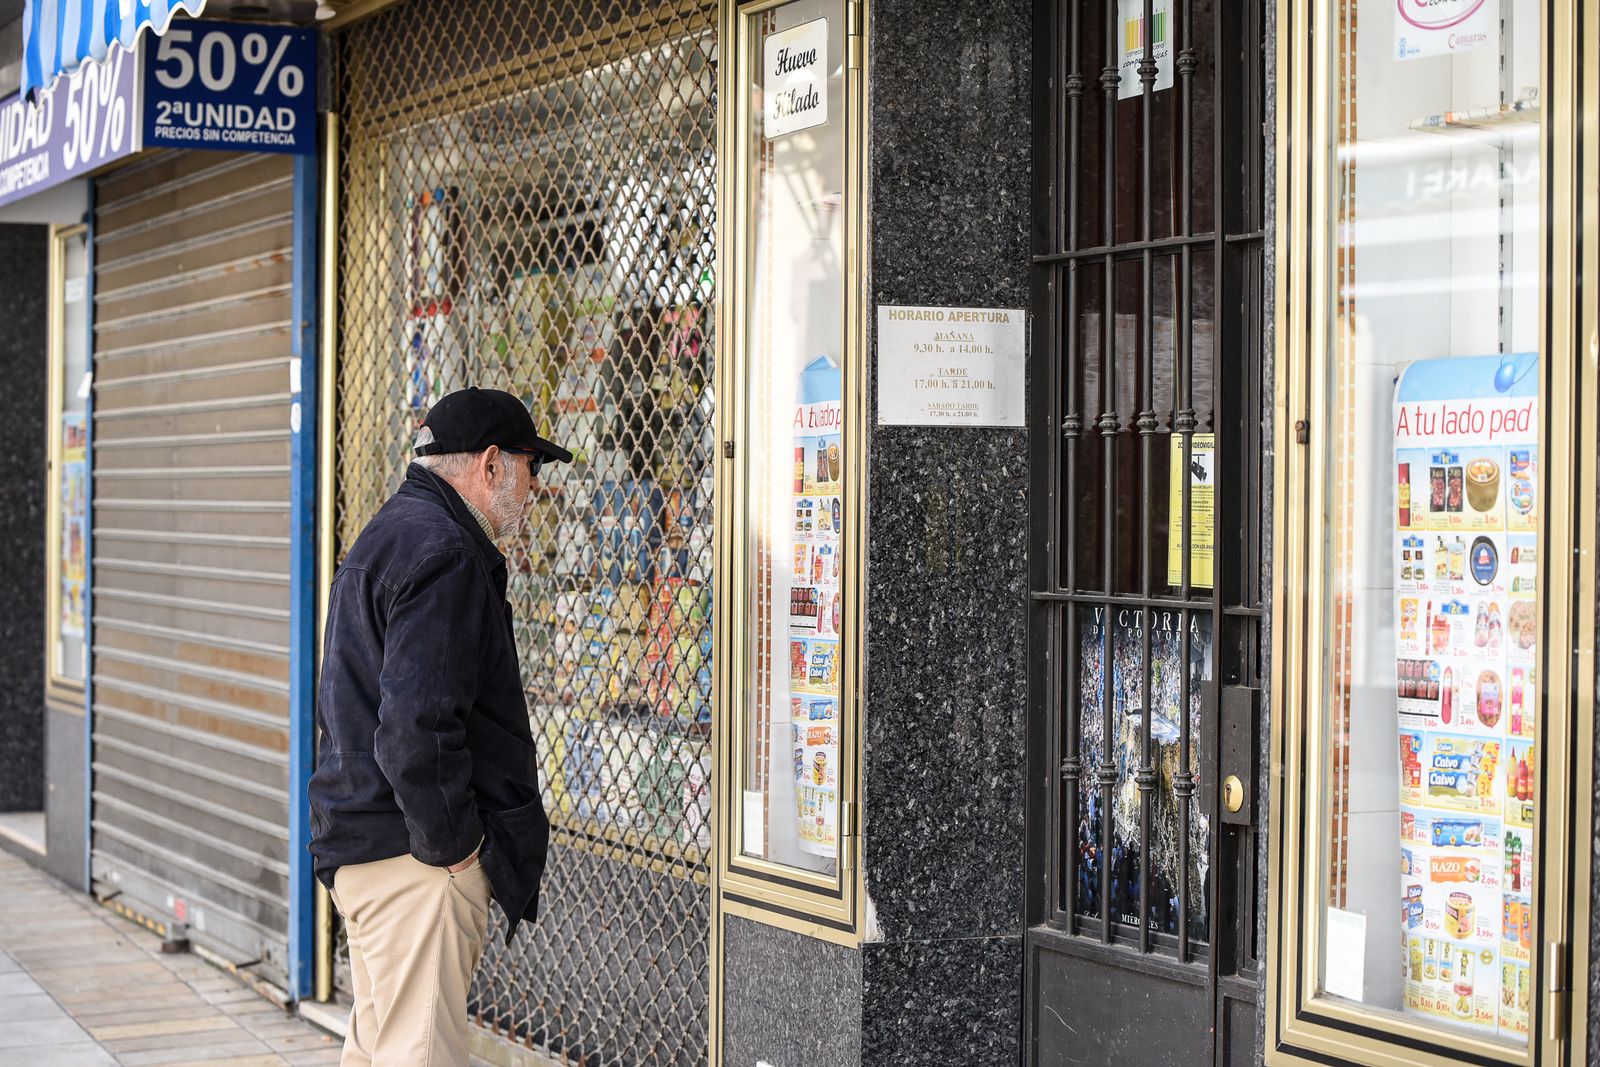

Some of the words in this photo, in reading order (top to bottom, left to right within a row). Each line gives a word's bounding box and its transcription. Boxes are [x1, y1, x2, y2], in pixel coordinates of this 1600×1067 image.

[155, 29, 304, 97] 50%
[775, 47, 817, 76] Huevo
[63, 50, 126, 170] 50%
[773, 83, 819, 120] Hilado
[155, 126, 200, 140] PRECIOS
[202, 128, 220, 141] SIN
[222, 130, 296, 145] COMPETENCIA
[889, 309, 945, 321] HORARIO
[948, 310, 1010, 324] APERTURA
[935, 331, 975, 341] MAÑANA
[914, 343, 933, 354] 9,30
[936, 344, 945, 353] h.
[959, 344, 983, 354] 14,00
[985, 345, 993, 354] h.
[937, 368, 968, 376] TARDE
[914, 379, 938, 390] 17,00
[941, 380, 950, 389] h.
[961, 380, 985, 390] 21,00
[987, 381, 995, 390] h.
[793, 407, 804, 428] A
[1397, 406, 1410, 436] A
[1415, 405, 1435, 436] tu
[1441, 403, 1484, 435] lado
[1094, 607, 1200, 633] VCTORIA
[1434, 757, 1459, 768] Calvo
[1430, 773, 1456, 786] Calvo
[1431, 861, 1460, 873] RAZO
